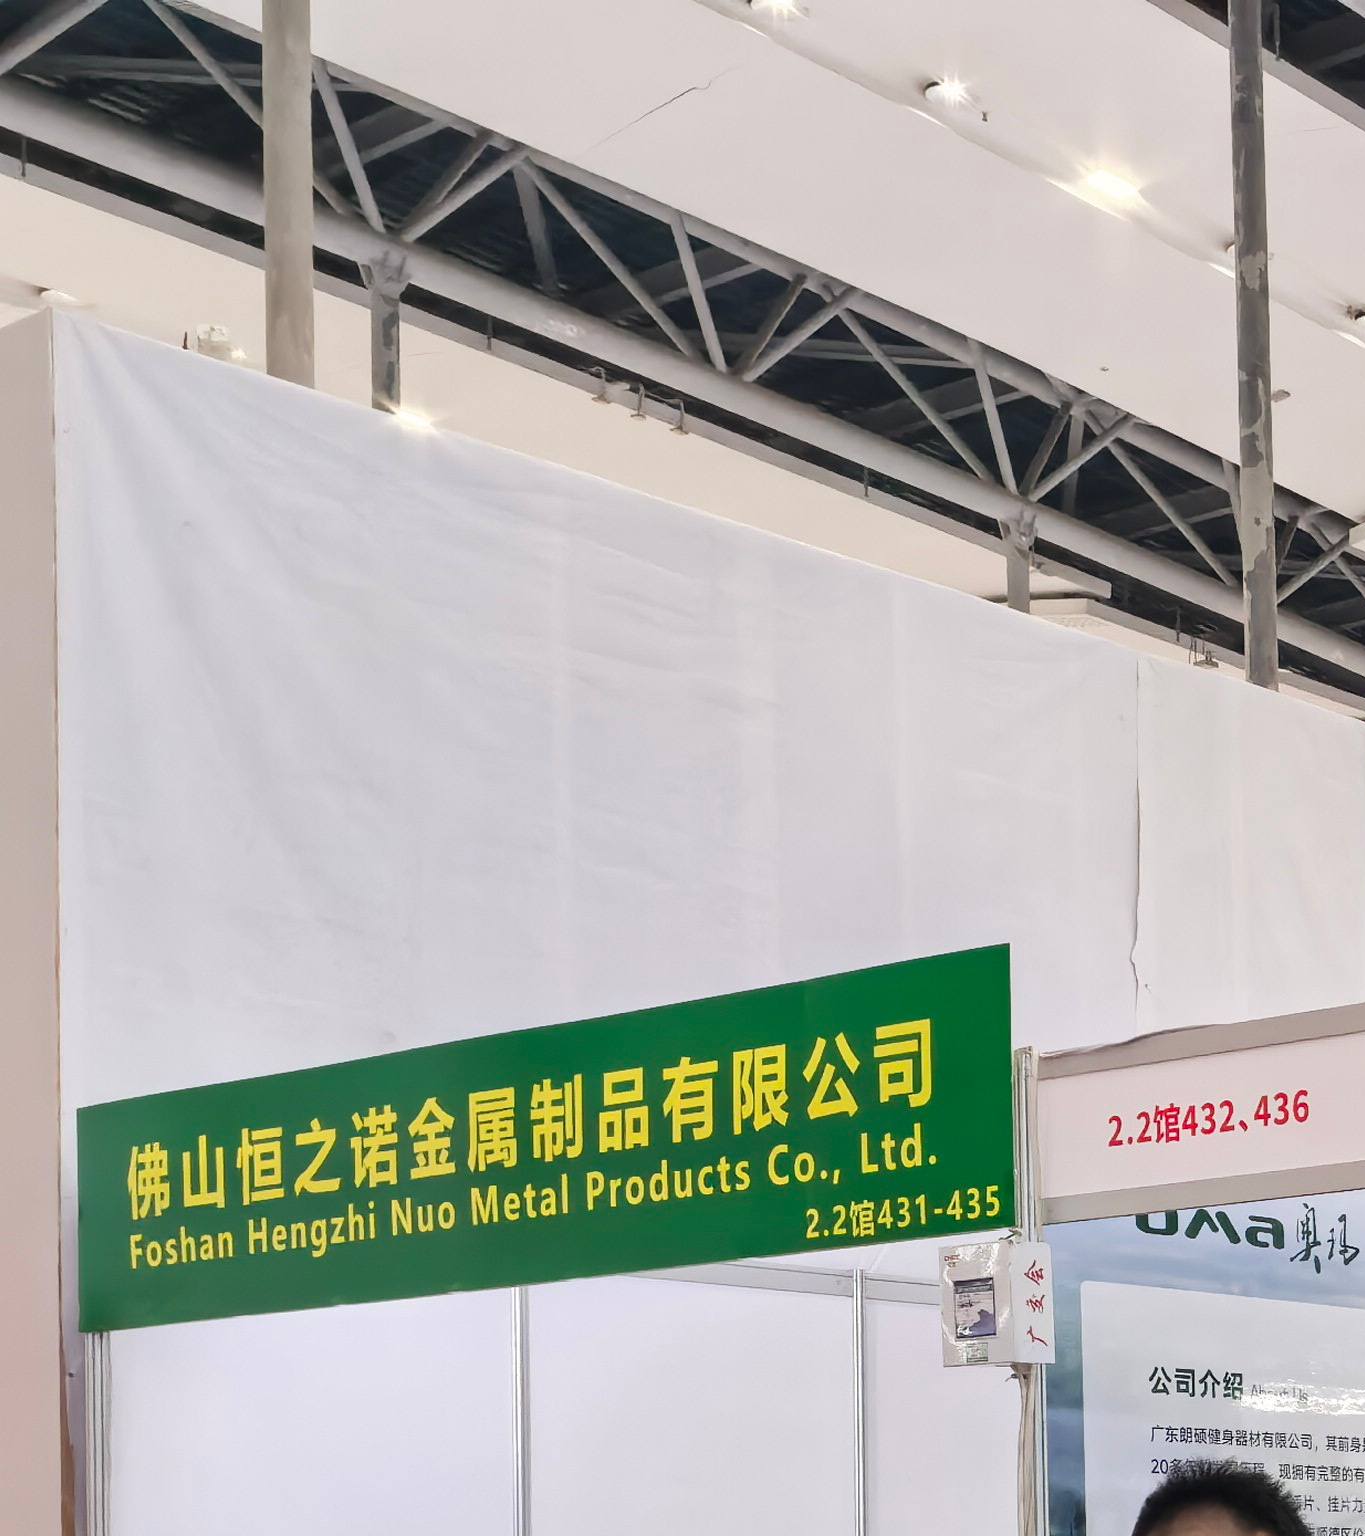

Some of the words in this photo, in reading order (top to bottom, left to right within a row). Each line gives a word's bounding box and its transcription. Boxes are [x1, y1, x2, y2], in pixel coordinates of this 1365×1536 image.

[127, 1018, 936, 1222] 佛山恒之诺金属制品有限公司
[1108, 1089, 1310, 1147] 2.2馆432、436
[129, 1227, 234, 1270] Foshan
[246, 1202, 376, 1258] Hengzhi
[391, 1198, 456, 1237] Nuo
[471, 1174, 569, 1225] Metal
[587, 1157, 751, 1211] Products
[768, 1144, 841, 1187] Co.,
[861, 1127, 937, 1174] Ltd.
[804, 1183, 1000, 1240] 2.2馆431-435
[1149, 1366, 1243, 1401] 公司介绍
